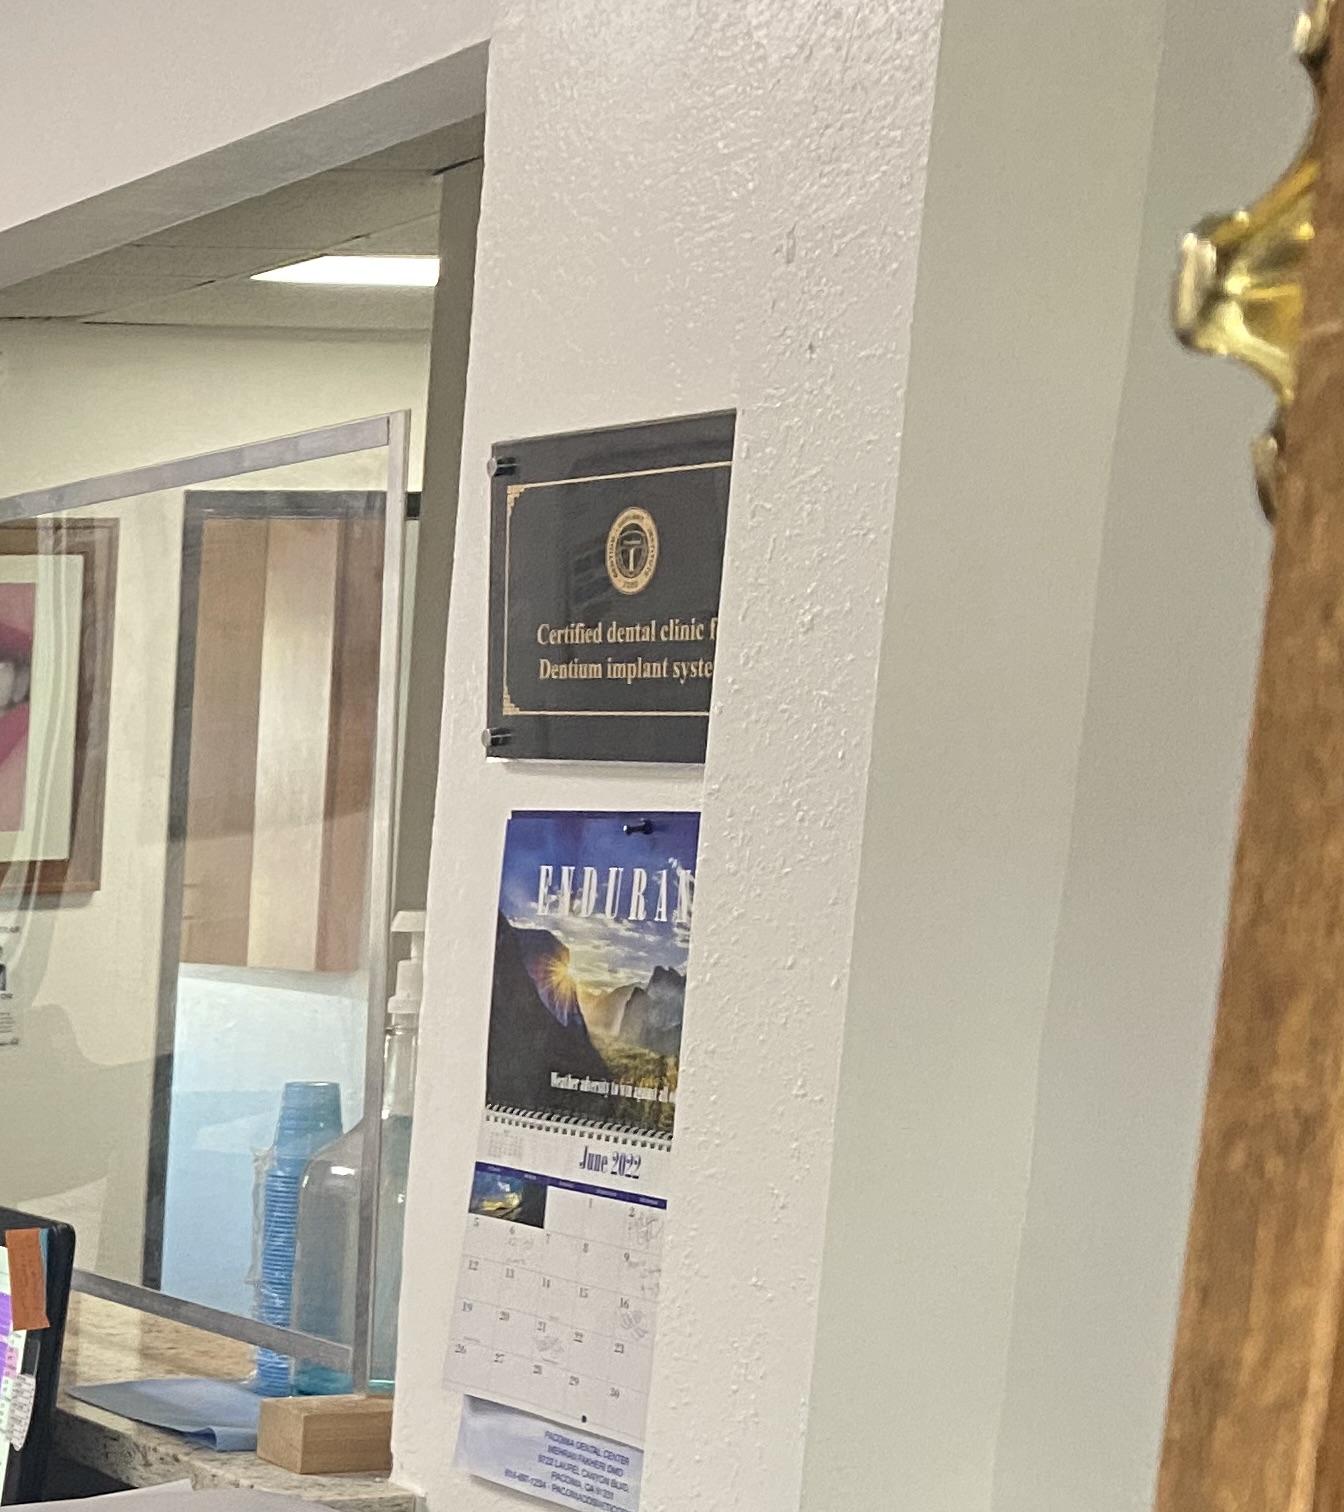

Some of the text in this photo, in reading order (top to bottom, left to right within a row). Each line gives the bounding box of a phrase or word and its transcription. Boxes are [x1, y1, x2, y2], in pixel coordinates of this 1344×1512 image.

[536, 622, 602, 645] Certified
[606, 620, 656, 643] dental
[660, 618, 704, 642] clinic
[538, 658, 602, 680] Dentium
[606, 656, 669, 684] implant
[578, 1144, 642, 1179] June 2022
[603, 1450, 630, 1466] CENTER
